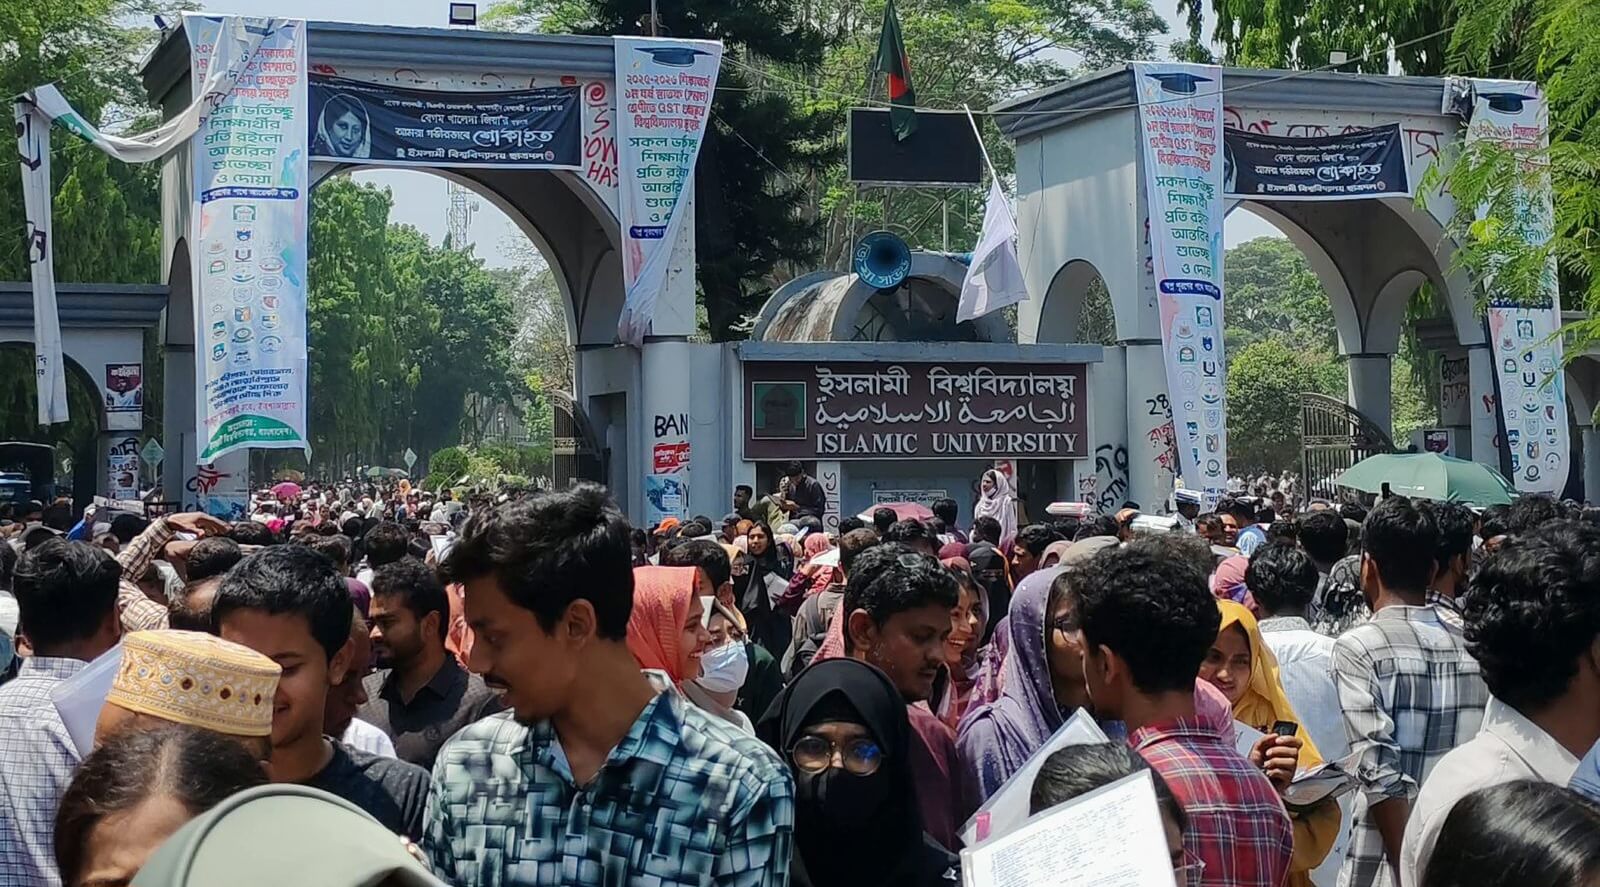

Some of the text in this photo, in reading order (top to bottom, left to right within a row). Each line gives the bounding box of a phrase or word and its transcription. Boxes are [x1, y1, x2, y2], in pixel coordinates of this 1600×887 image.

[658, 103, 681, 114] GST
[210, 117, 281, 129] শিক্ষার্থীর
[421, 113, 444, 124] বেগম
[447, 114, 478, 125] খালেদা
[204, 130, 232, 145] প্রতি
[395, 127, 554, 149] আমরা গভীরভাবে শোকাহত
[629, 137, 667, 147] সকল
[208, 145, 277, 157] আন্তরিক
[407, 147, 544, 161] ইসলামী বিশ্ববিদ্যালয় ছাত্রদল
[213, 160, 272, 171] শুভেচ্ছা
[636, 164, 662, 179] প্রতি
[1317, 162, 1382, 182] শোকাহত
[216, 174, 272, 185] ও দোয়া
[1155, 176, 1188, 188] সকল
[649, 212, 660, 223] ও
[1165, 207, 1188, 223] প্রতি
[1181, 263, 1191, 275] ও
[815, 364, 1078, 399] ইসলামী বিশ্ববিদ্যালয়
[815, 396, 1076, 430] الجامعة الاسلامية
[654, 412, 688, 438] BAN
[816, 433, 1078, 454] ISLAMIC UNIVERSITY
